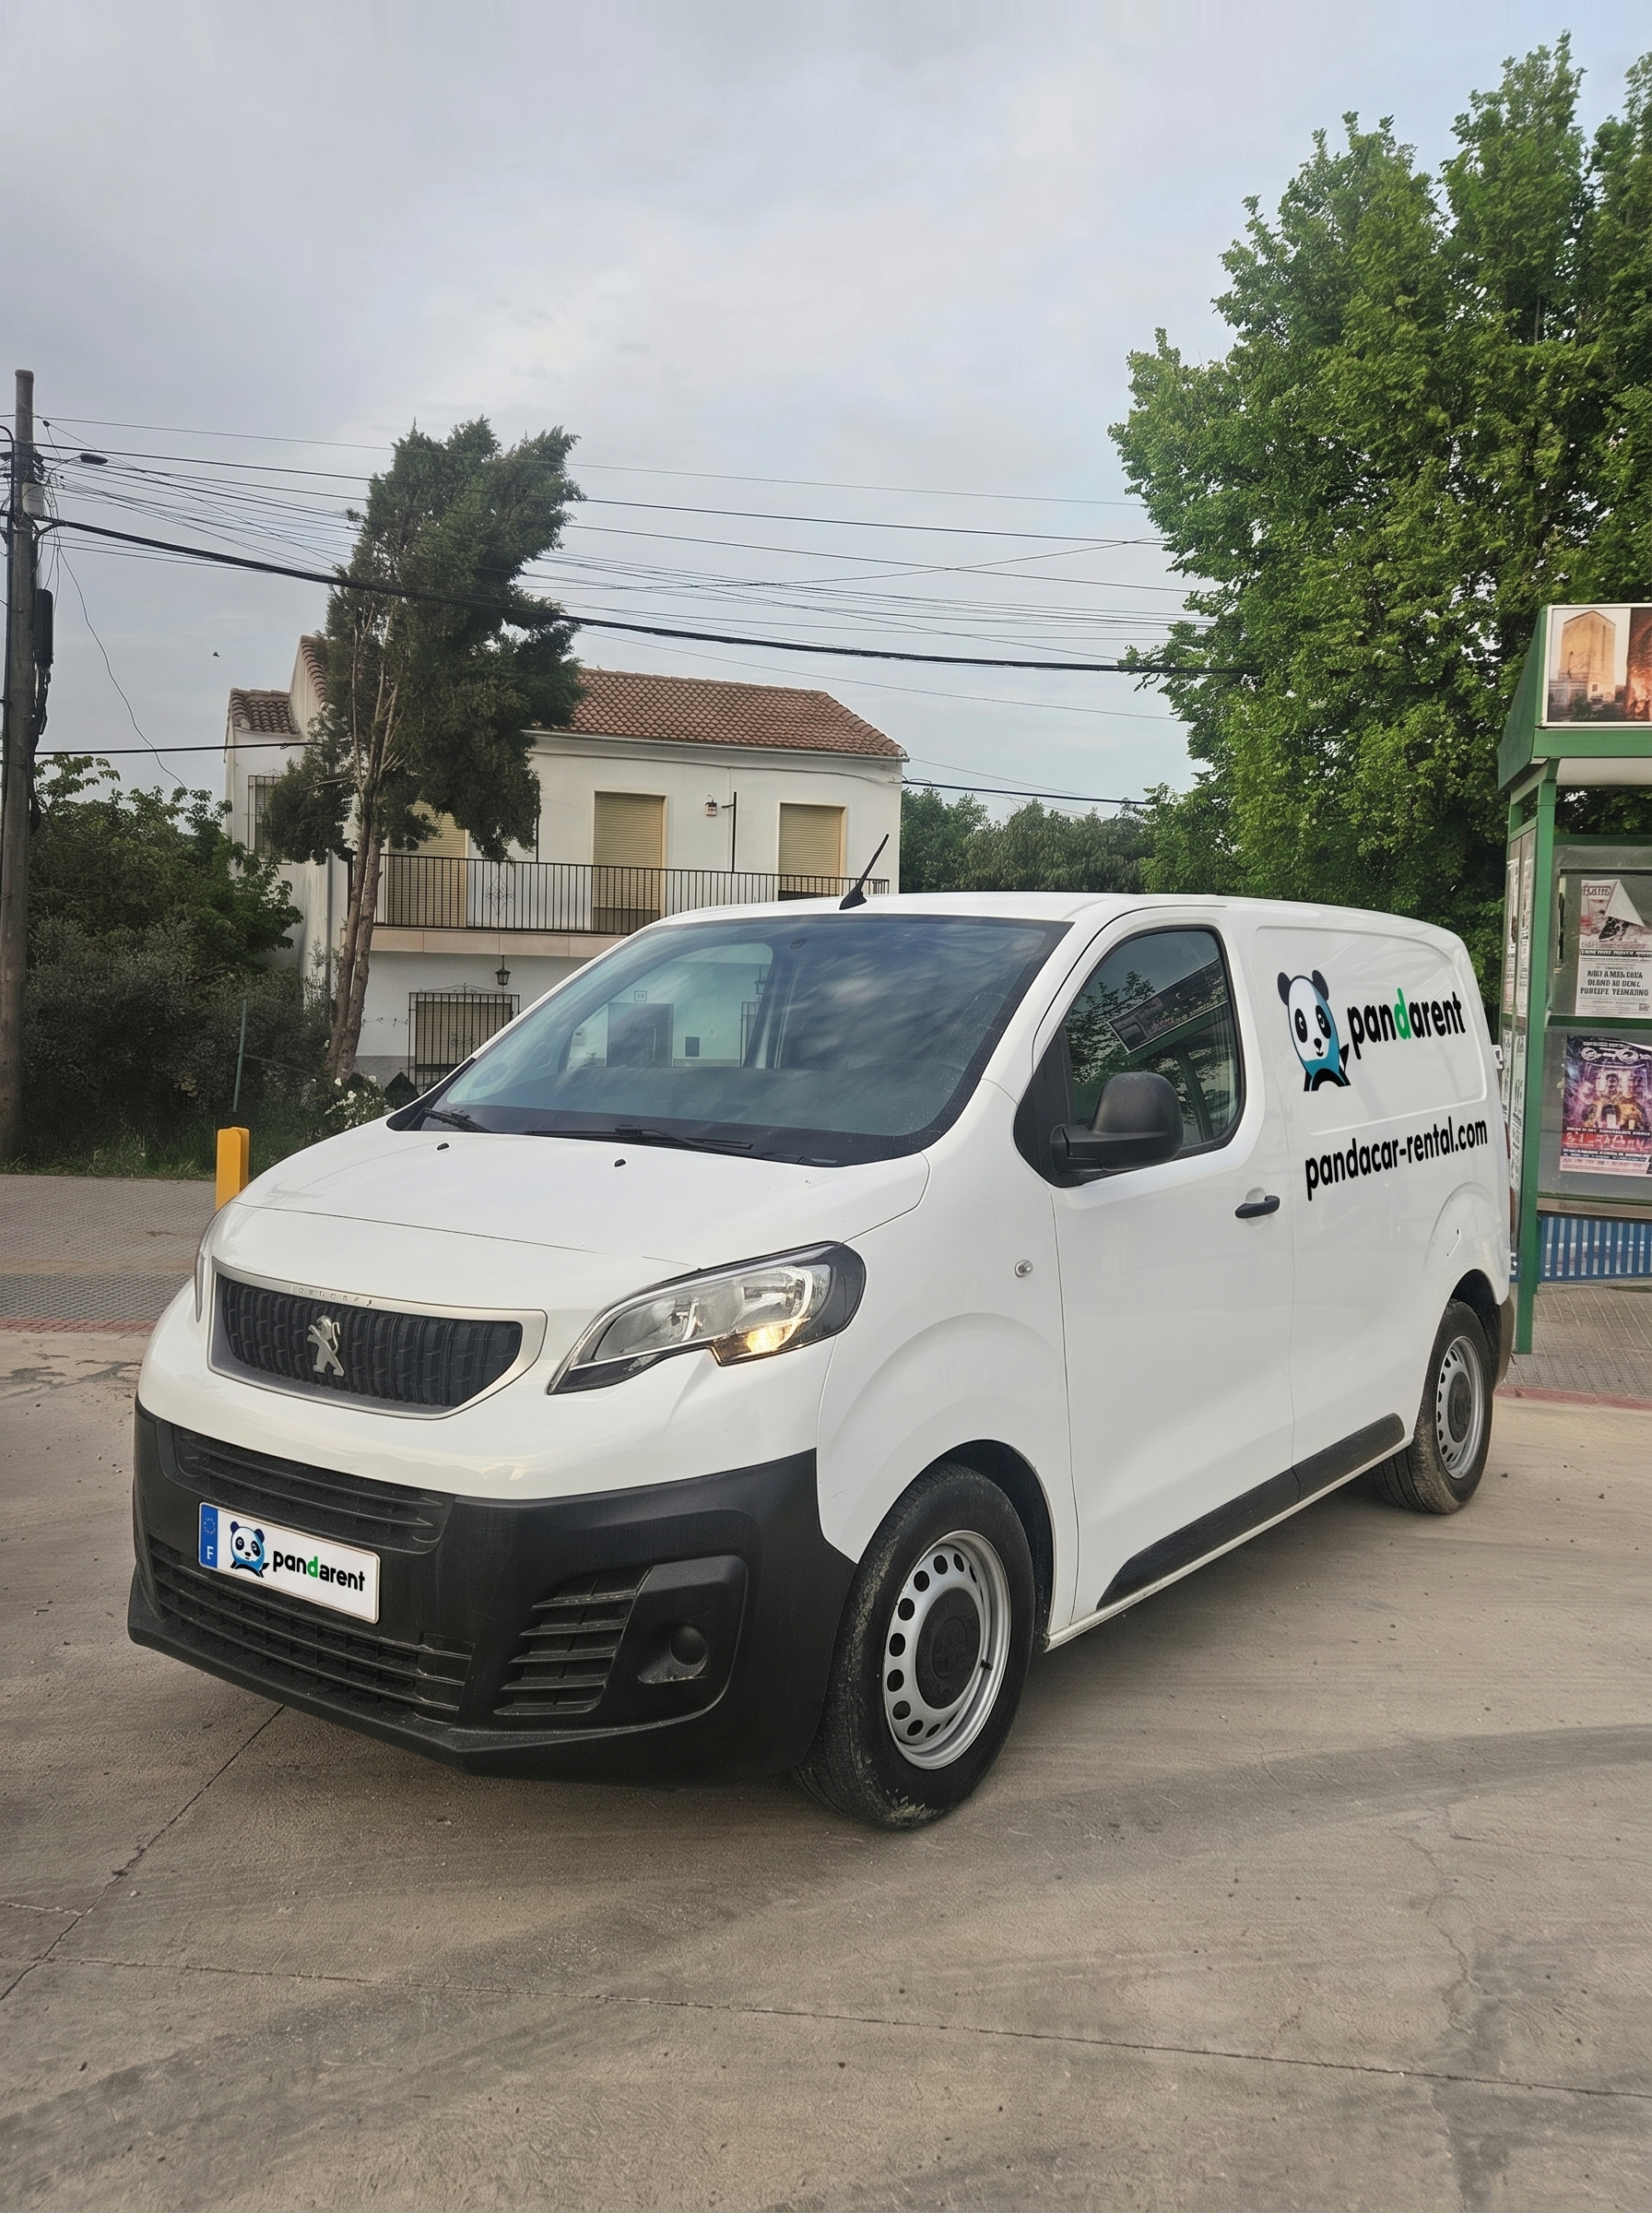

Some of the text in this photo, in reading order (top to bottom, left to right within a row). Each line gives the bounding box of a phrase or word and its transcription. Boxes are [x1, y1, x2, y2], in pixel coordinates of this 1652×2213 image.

[1347, 988, 1466, 1059] pandarent
[1305, 1116, 1488, 1201] pandacar-rental.com
[206, 1545, 214, 1560] F
[273, 1550, 365, 1592] pandarent
